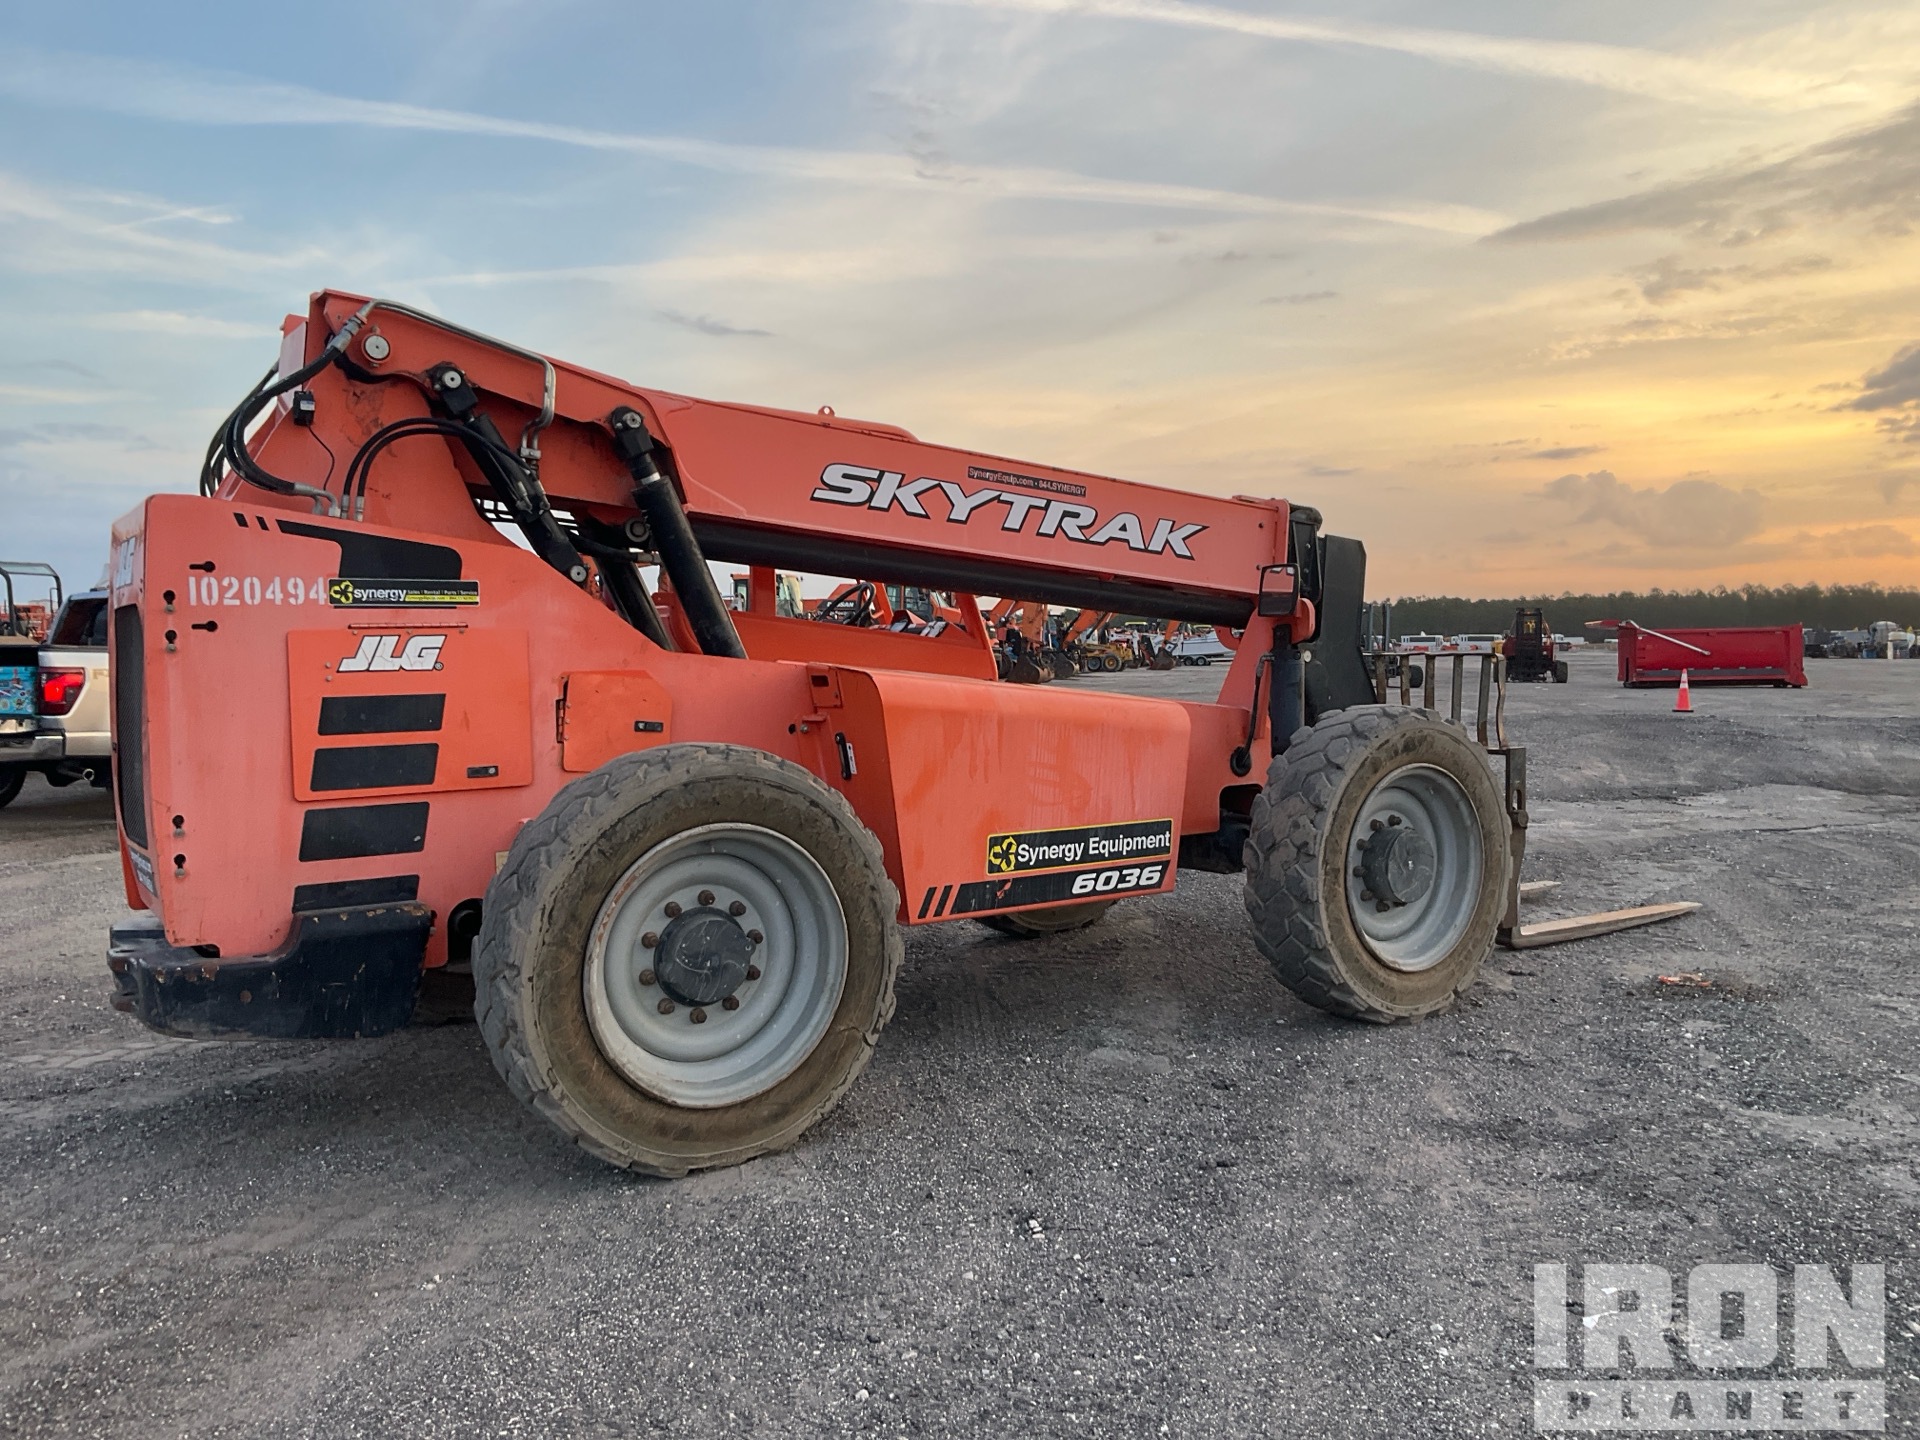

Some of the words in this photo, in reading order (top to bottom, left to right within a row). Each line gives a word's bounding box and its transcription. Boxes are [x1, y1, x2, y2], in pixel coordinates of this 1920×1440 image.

[969, 467, 1034, 487] SynergyEquip.com
[811, 463, 1209, 561] SKYTRAK
[353, 588, 406, 601] synergy
[336, 634, 447, 673] JLG
[1017, 842, 1084, 866] Synergy
[1088, 830, 1171, 858] Equipment
[1071, 865, 1162, 895] 6036
